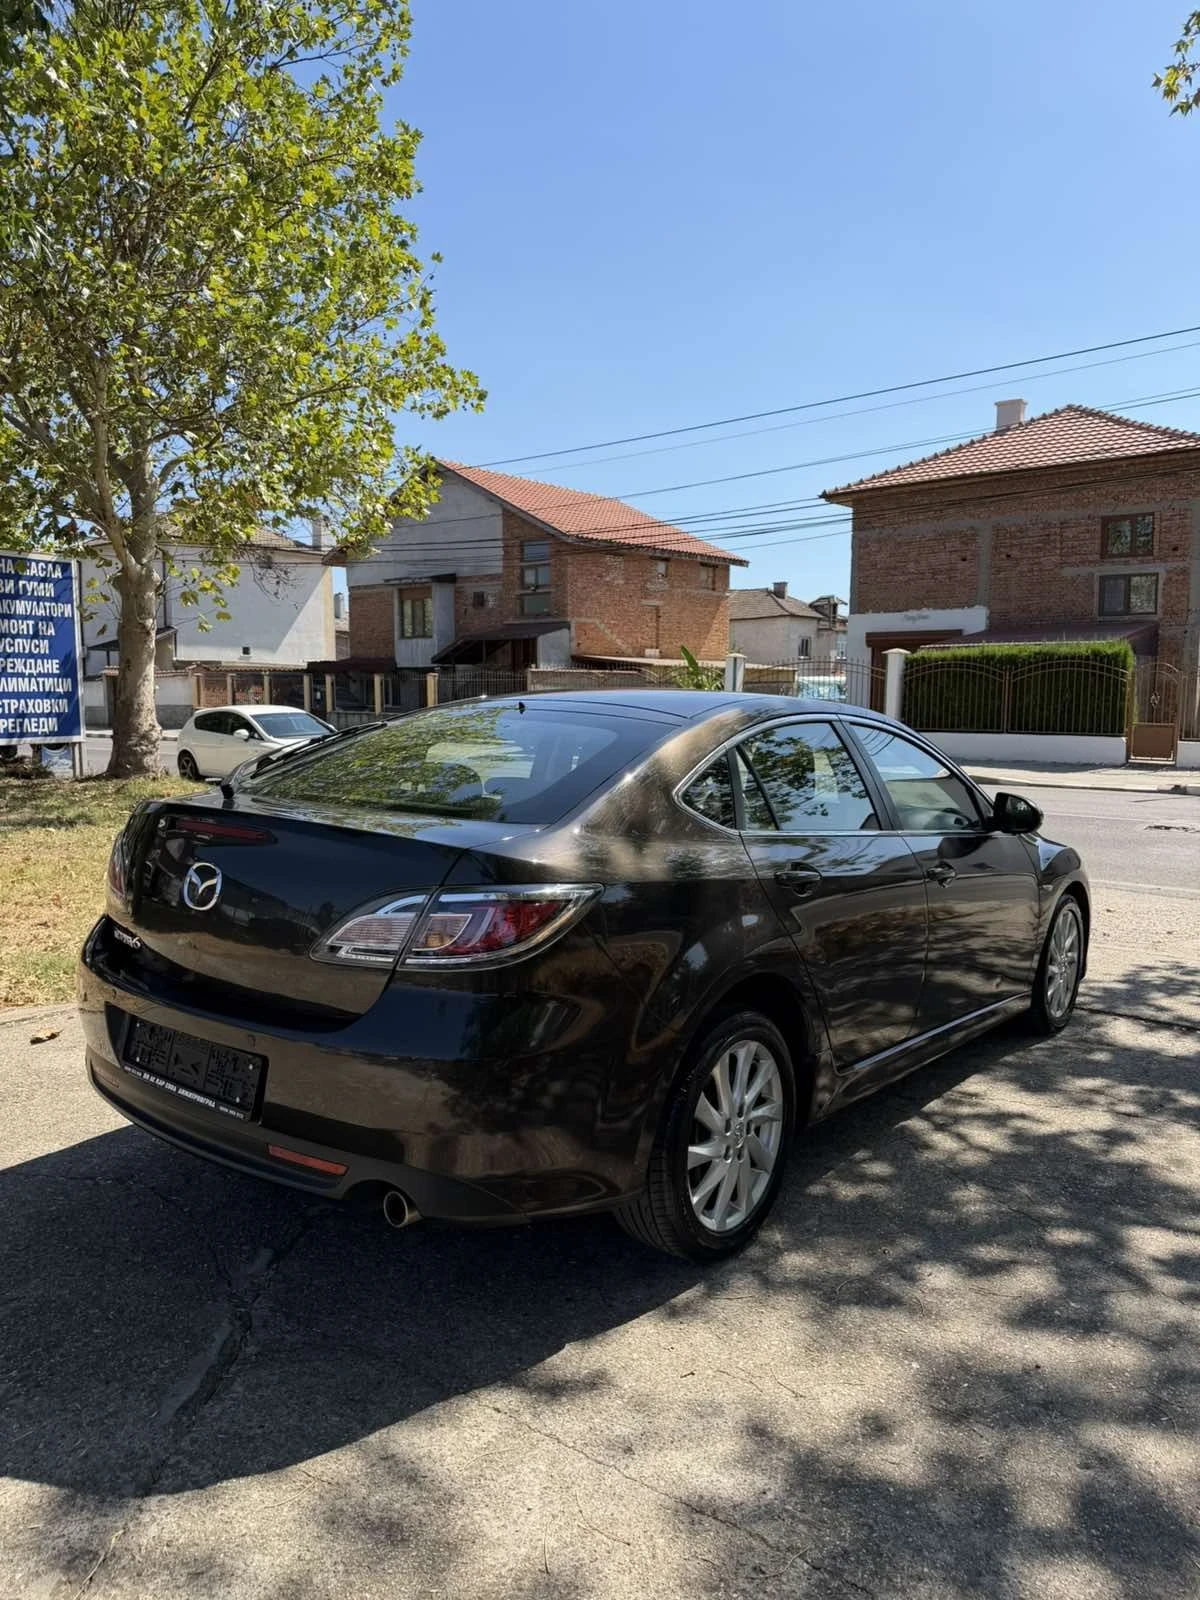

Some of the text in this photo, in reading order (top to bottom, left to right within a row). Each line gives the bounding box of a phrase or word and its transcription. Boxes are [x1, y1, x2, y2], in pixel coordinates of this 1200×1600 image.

[18, 560, 62, 578] АСЛА
[18, 580, 54, 598] ГУМИ
[0, 599, 72, 618] КУМУЛАТОРИ
[0, 618, 56, 636] МОНТ НА
[0, 677, 72, 694] ЛИМАТИЦИ
[0, 717, 58, 735] РЕГЛЕДИ
